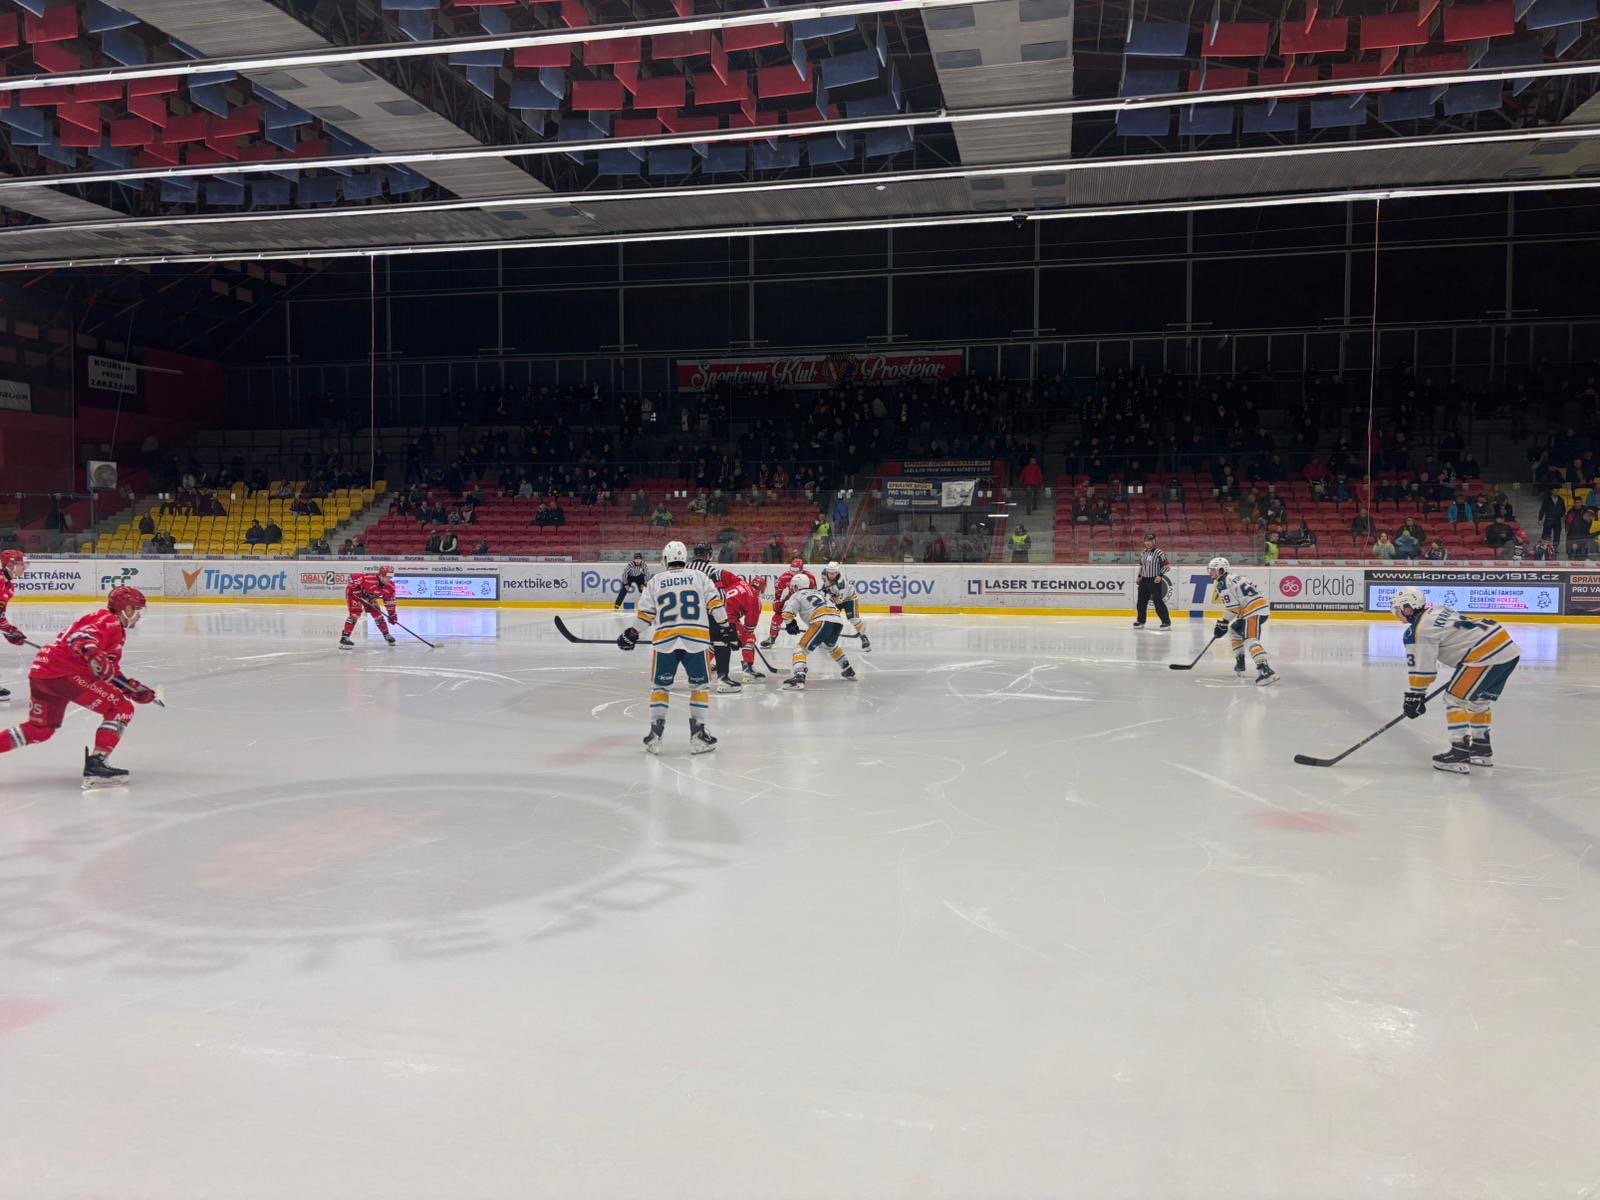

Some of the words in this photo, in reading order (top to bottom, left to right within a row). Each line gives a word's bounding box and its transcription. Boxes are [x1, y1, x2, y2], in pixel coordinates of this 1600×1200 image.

[205, 570, 287, 594] Tipsport
[503, 578, 552, 589] nextbike
[856, 575, 935, 600] ostějov
[985, 580, 1027, 590] LASER
[1032, 580, 1125, 592] TECHNOLOGY
[1305, 575, 1354, 596] rekola
[1372, 572, 1559, 583] www.skprostejov1913.cz
[657, 591, 700, 624] 28
